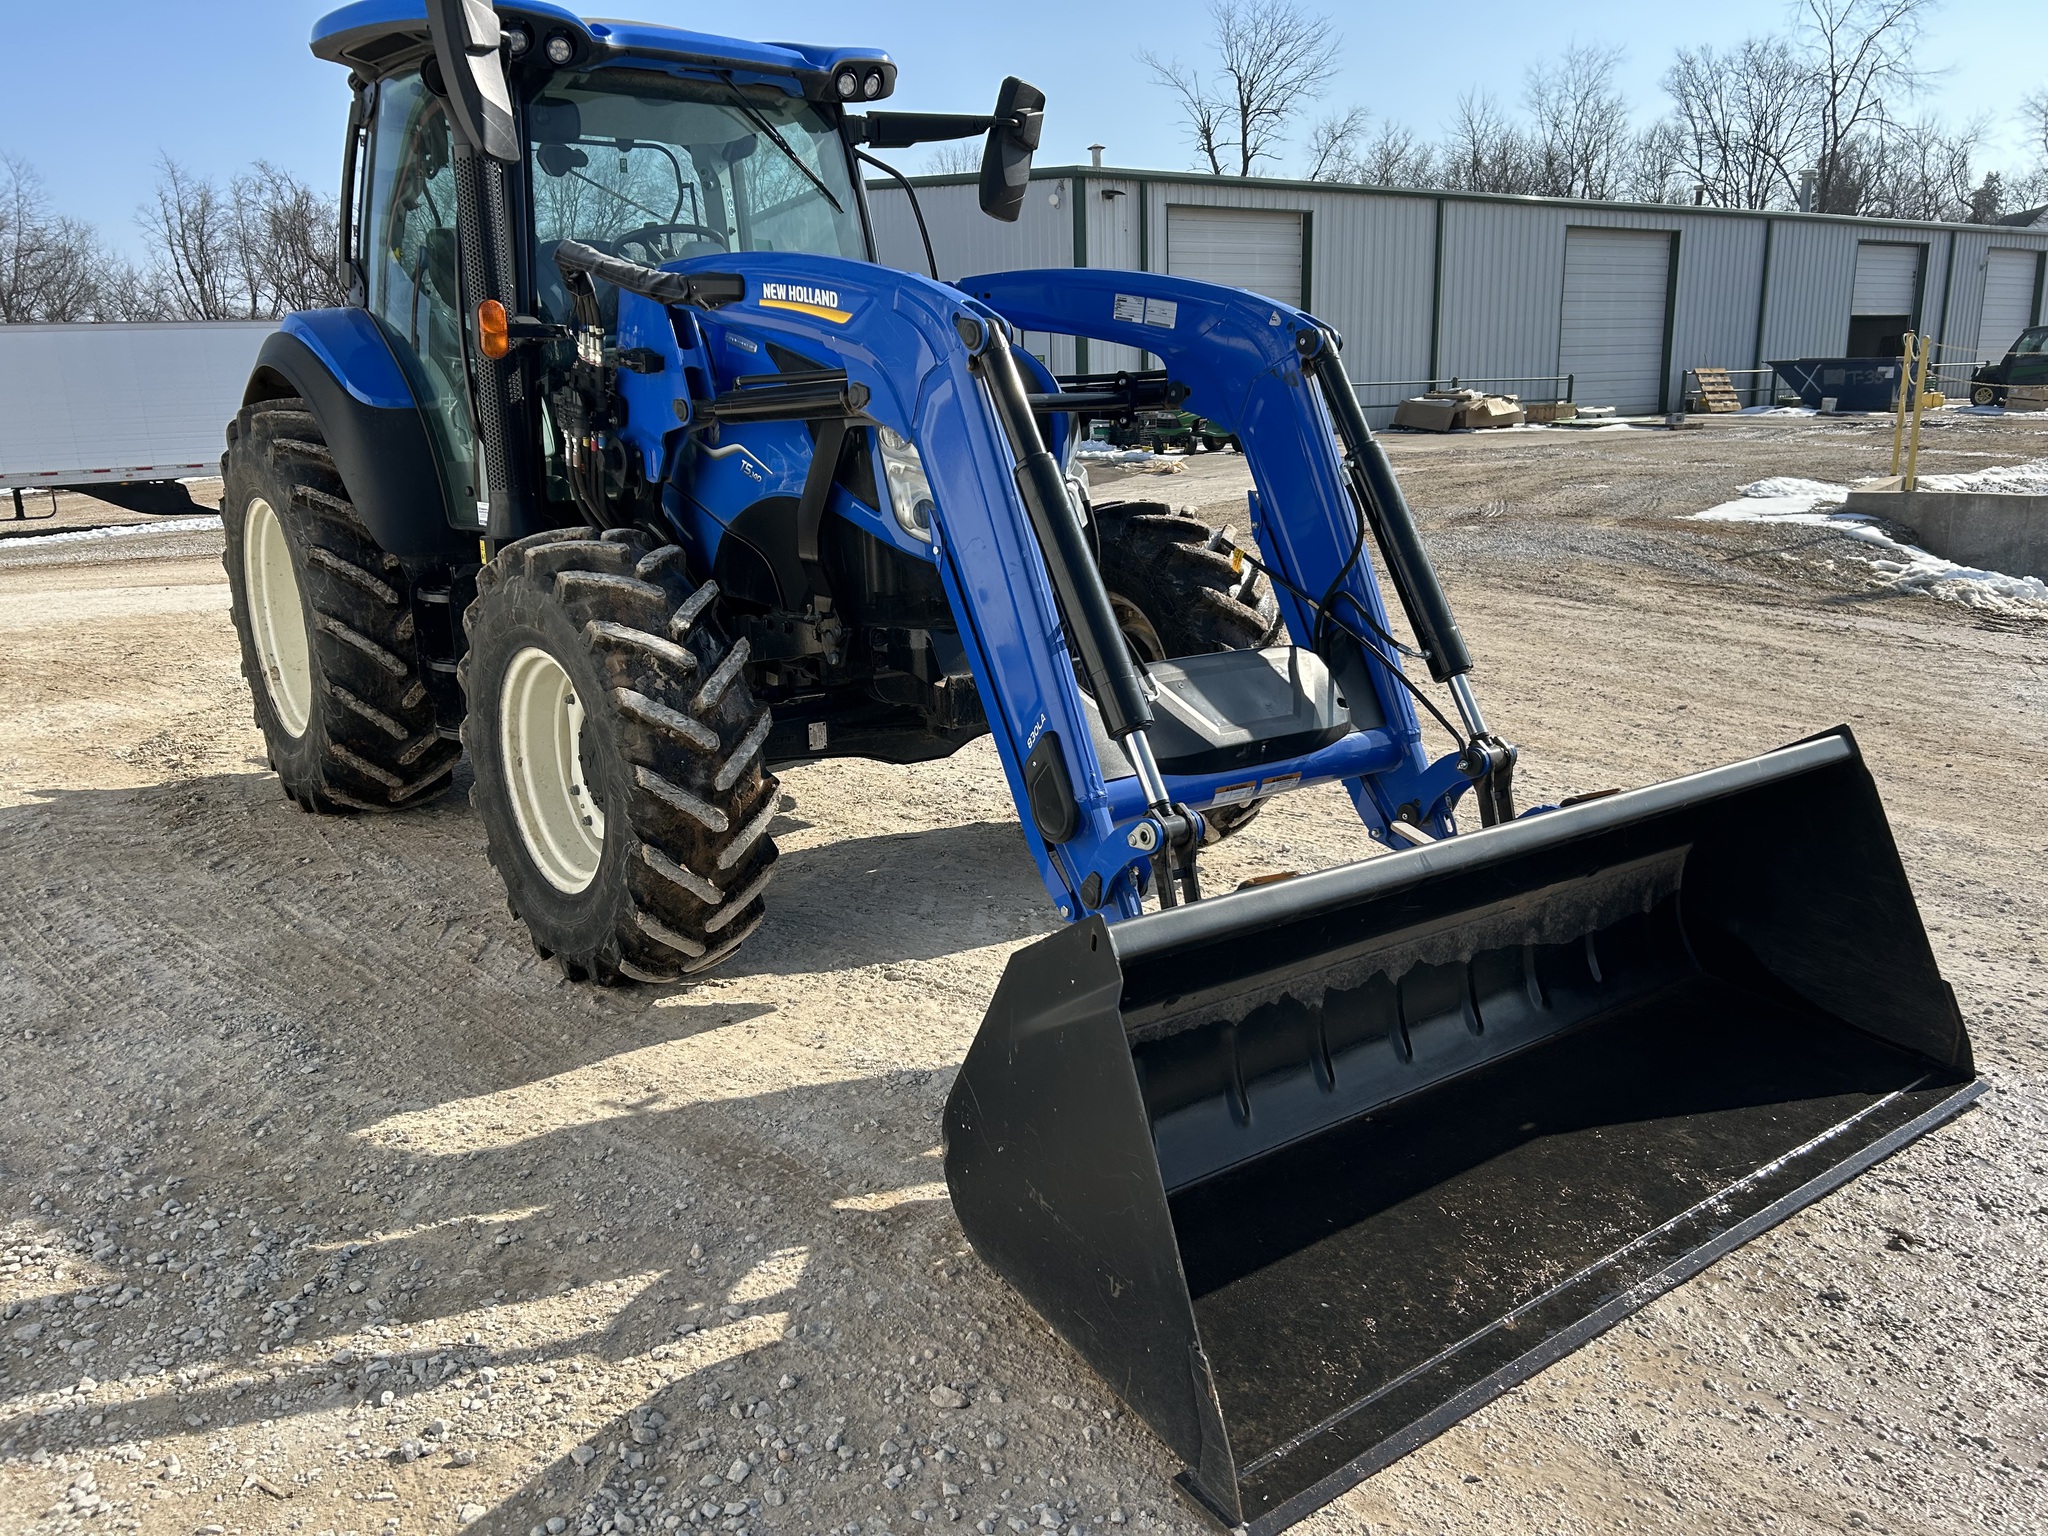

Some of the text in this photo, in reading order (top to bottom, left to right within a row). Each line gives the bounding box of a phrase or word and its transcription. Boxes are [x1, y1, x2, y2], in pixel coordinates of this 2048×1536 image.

[762, 282, 838, 308] NEW HOLLAND
[1026, 713, 1047, 749] 830LA
